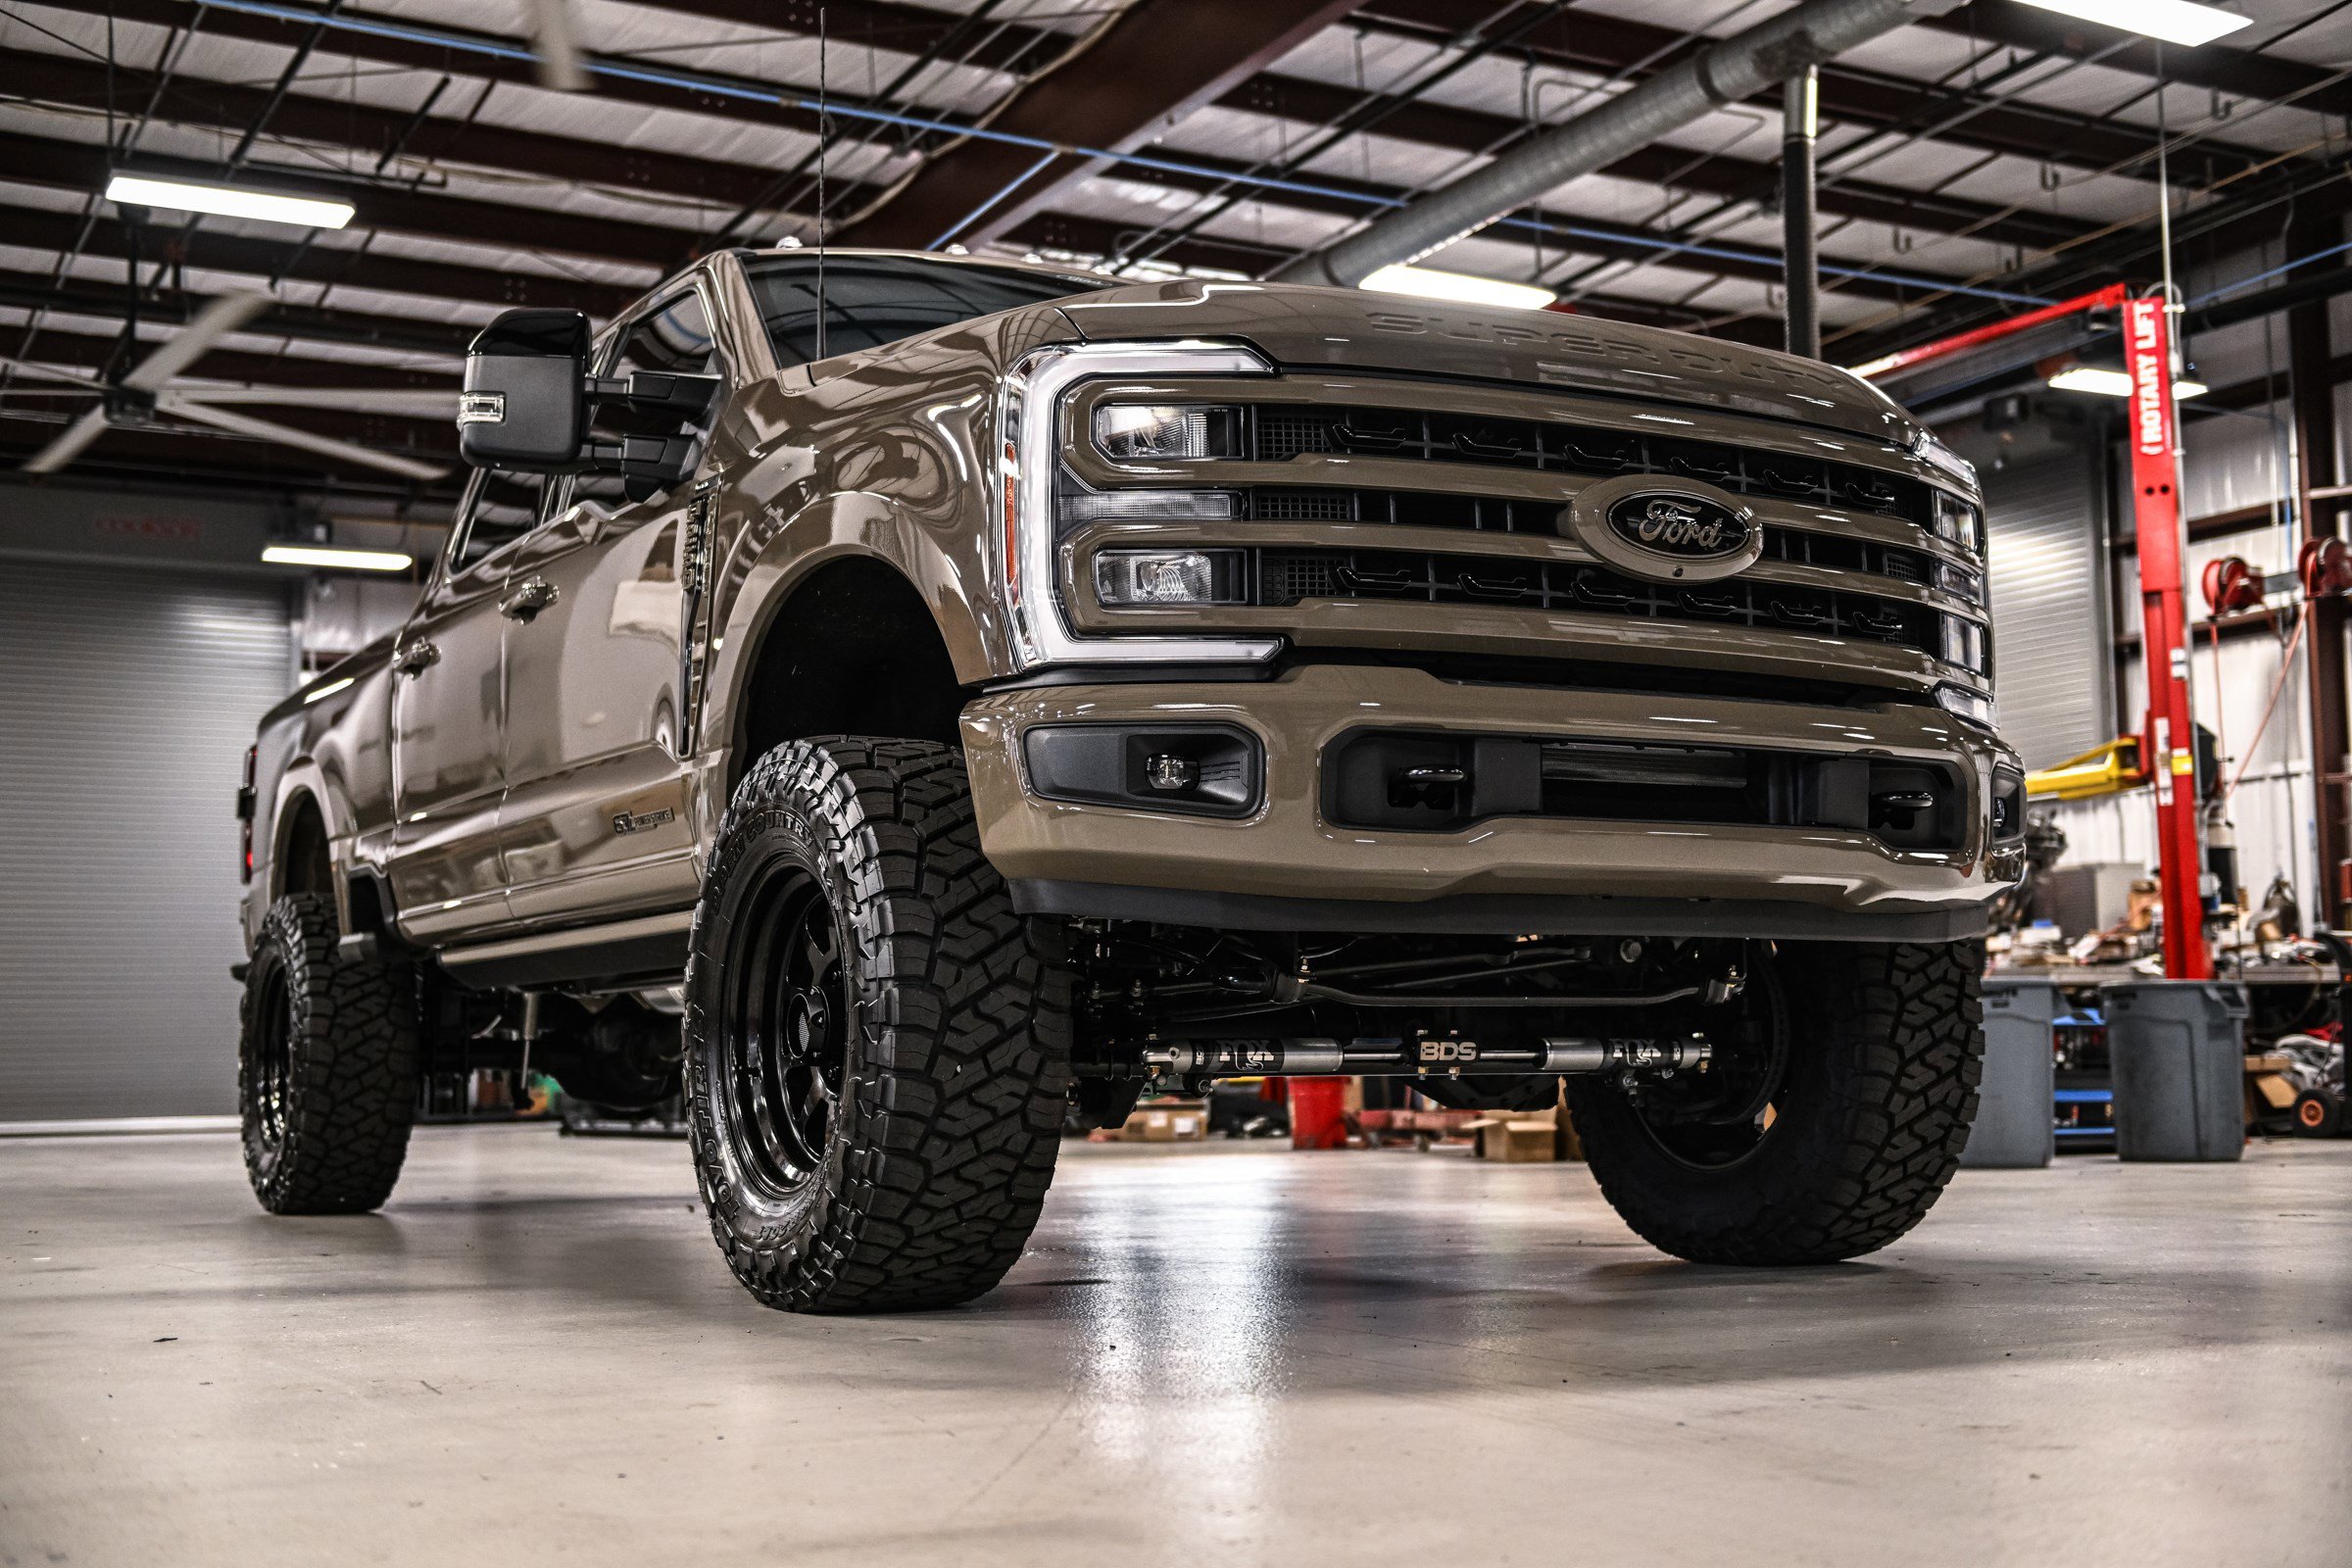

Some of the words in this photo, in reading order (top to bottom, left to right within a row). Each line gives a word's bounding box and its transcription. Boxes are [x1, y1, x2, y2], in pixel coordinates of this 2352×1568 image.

[2132, 301, 2157, 350] LIFT
[1366, 312, 1662, 365] SUPER
[1669, 348, 1843, 396] DUTY
[2136, 353, 2163, 444] ROTARY
[1639, 499, 1723, 548] Ford
[746, 809, 815, 848] COUNTRY
[1216, 1040, 1275, 1071] FOX
[1420, 1041, 1477, 1062] BDS
[1609, 1039, 1662, 1067] FOX
[704, 1139, 742, 1221] TOYO
